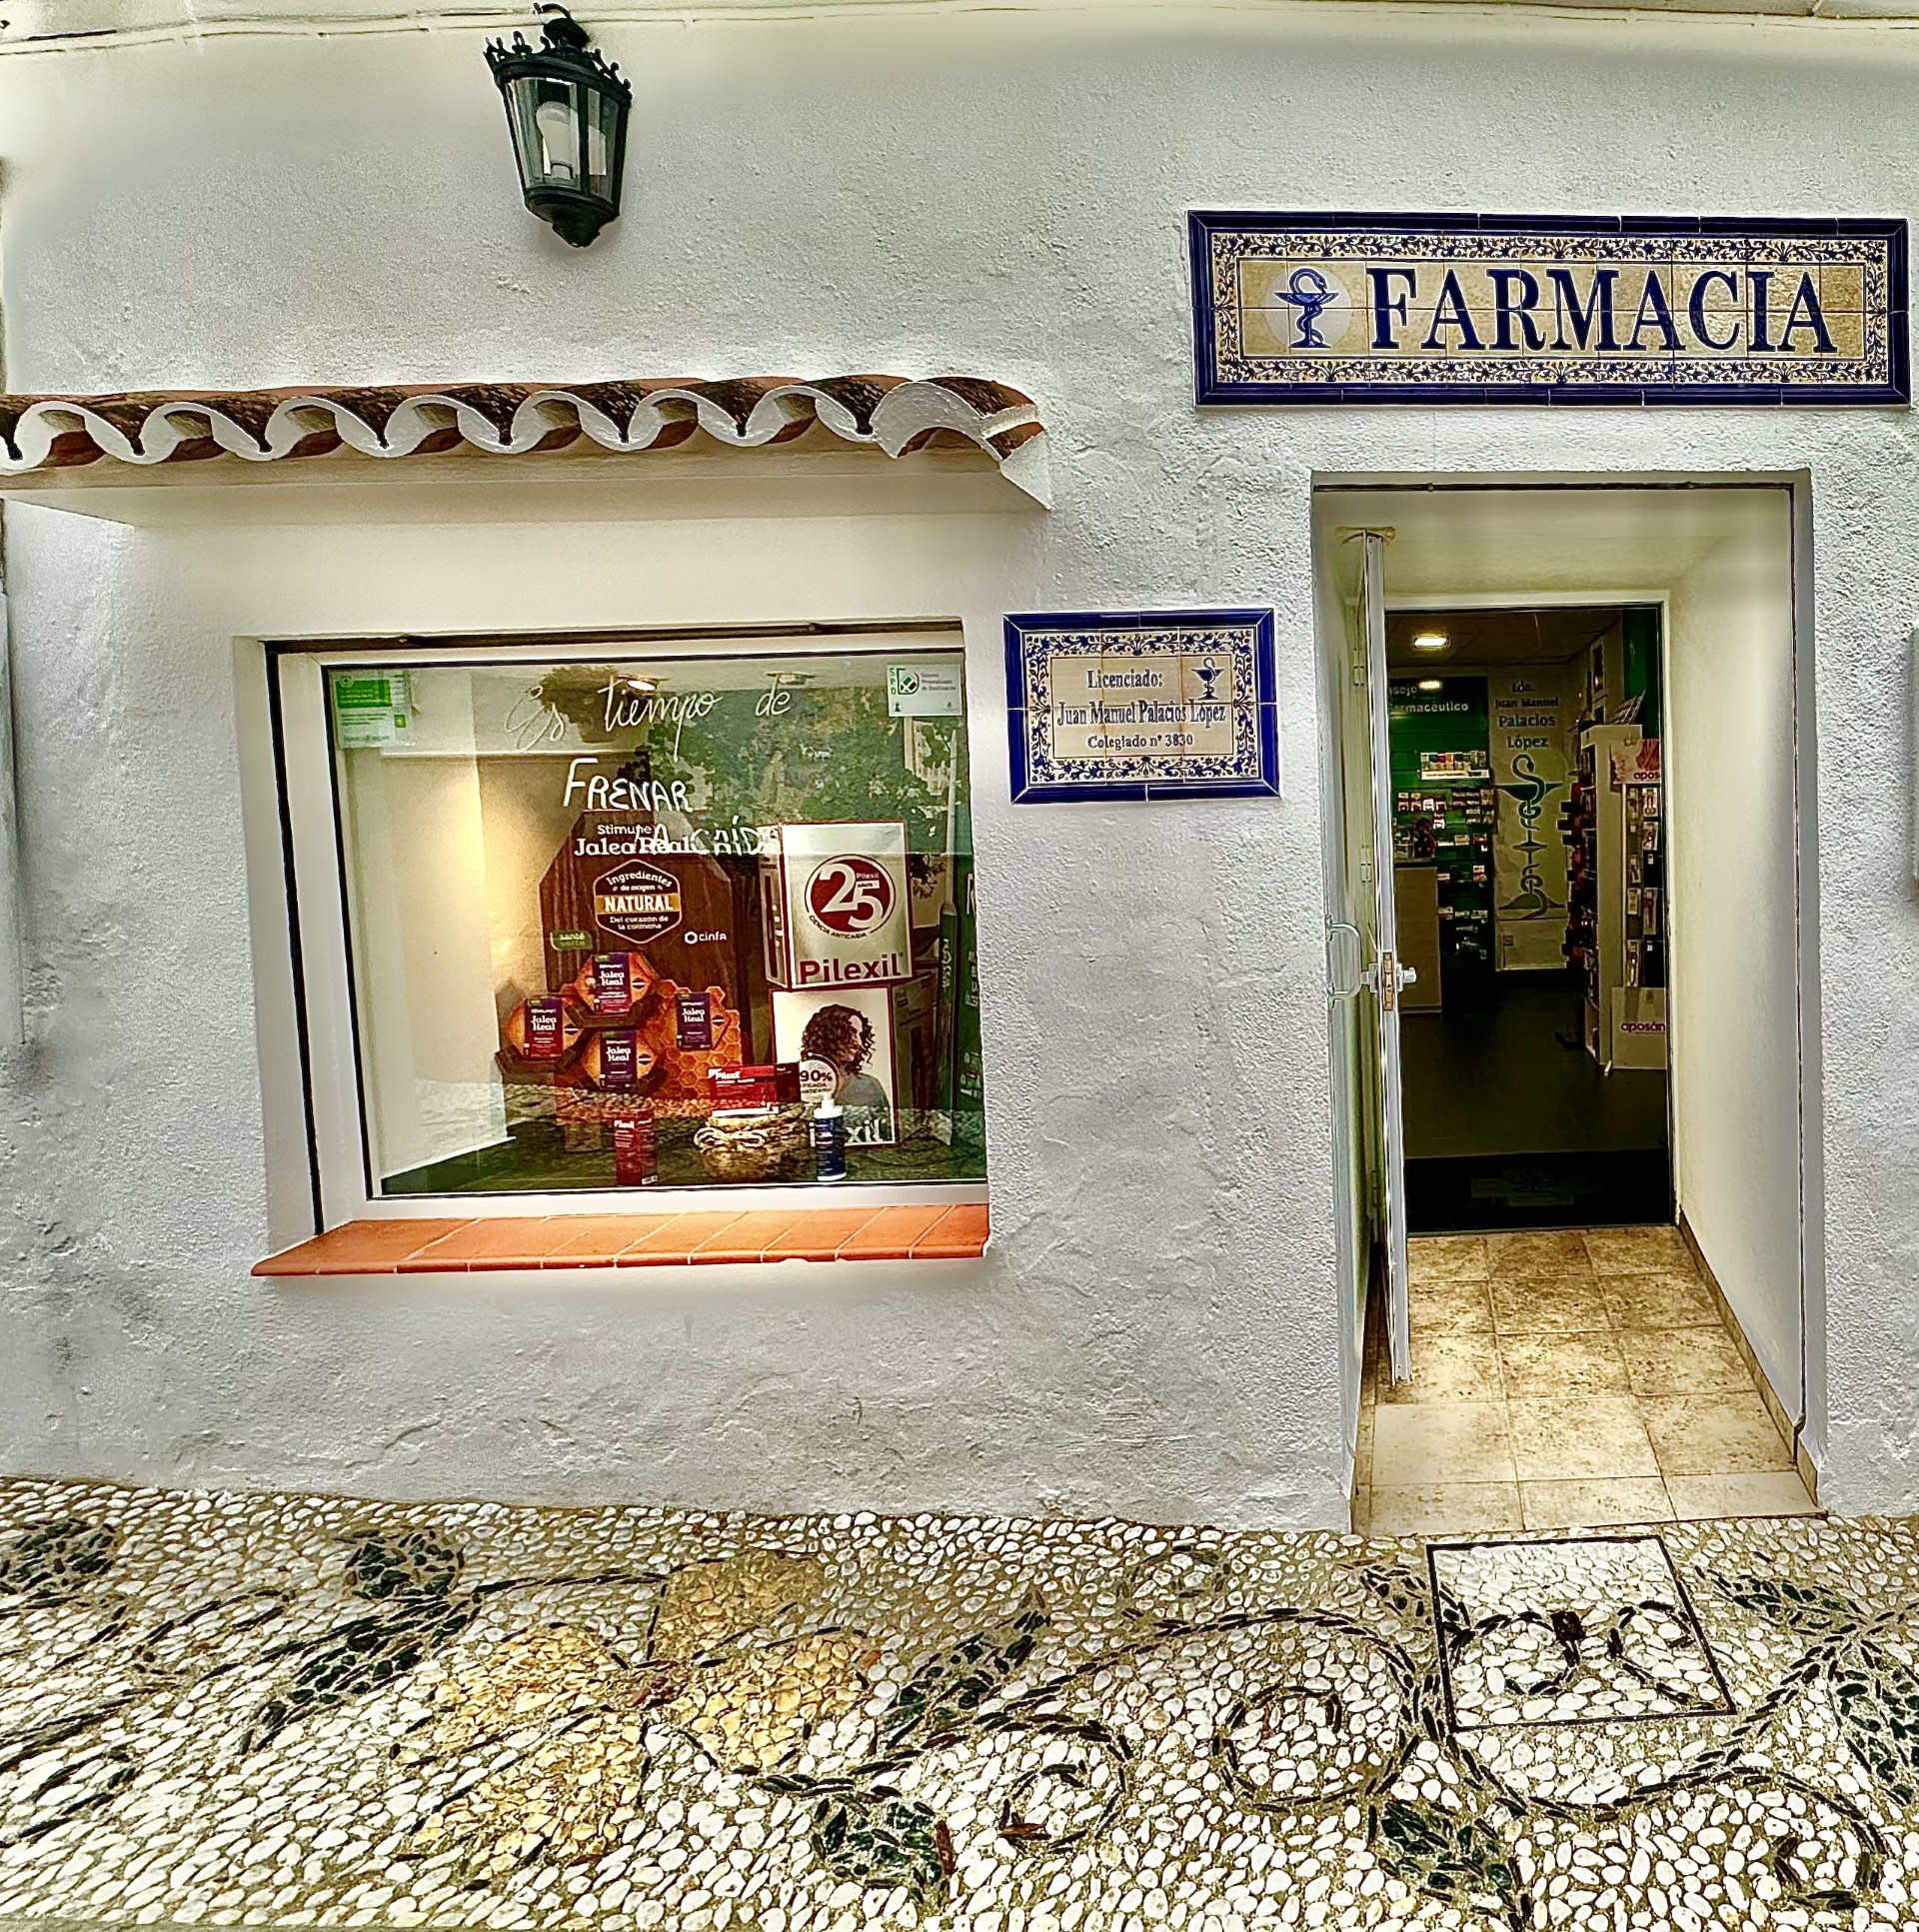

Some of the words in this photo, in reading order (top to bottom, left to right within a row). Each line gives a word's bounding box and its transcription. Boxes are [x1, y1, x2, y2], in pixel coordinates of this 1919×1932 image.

[1366, 267, 1837, 353] FARMACIA
[1087, 669, 1162, 689] Licenciado:
[1388, 684, 1417, 696] sejo
[598, 675, 723, 762] tiempo
[756, 675, 793, 717] de
[1057, 702, 1086, 726] Juan
[1089, 701, 1135, 724] Manuel
[1138, 700, 1186, 723] Palacios
[1188, 699, 1225, 729] López
[1499, 713, 1556, 728] Palacios
[1087, 735, 1146, 750] Colegiado
[1165, 734, 1193, 747] 3830
[1507, 734, 1548, 751] López
[563, 758, 694, 813] FRENAR
[1633, 771, 1660, 782] apos
[690, 815, 767, 856] CAÍD
[574, 838, 636, 856] Jalea
[639, 836, 691, 855] Real
[606, 871, 673, 888] Ingredientes
[604, 895, 674, 913] NATURAL
[820, 864, 884, 929] 25
[800, 954, 902, 984] Pilexil
[800, 1069, 833, 1081] 90%
